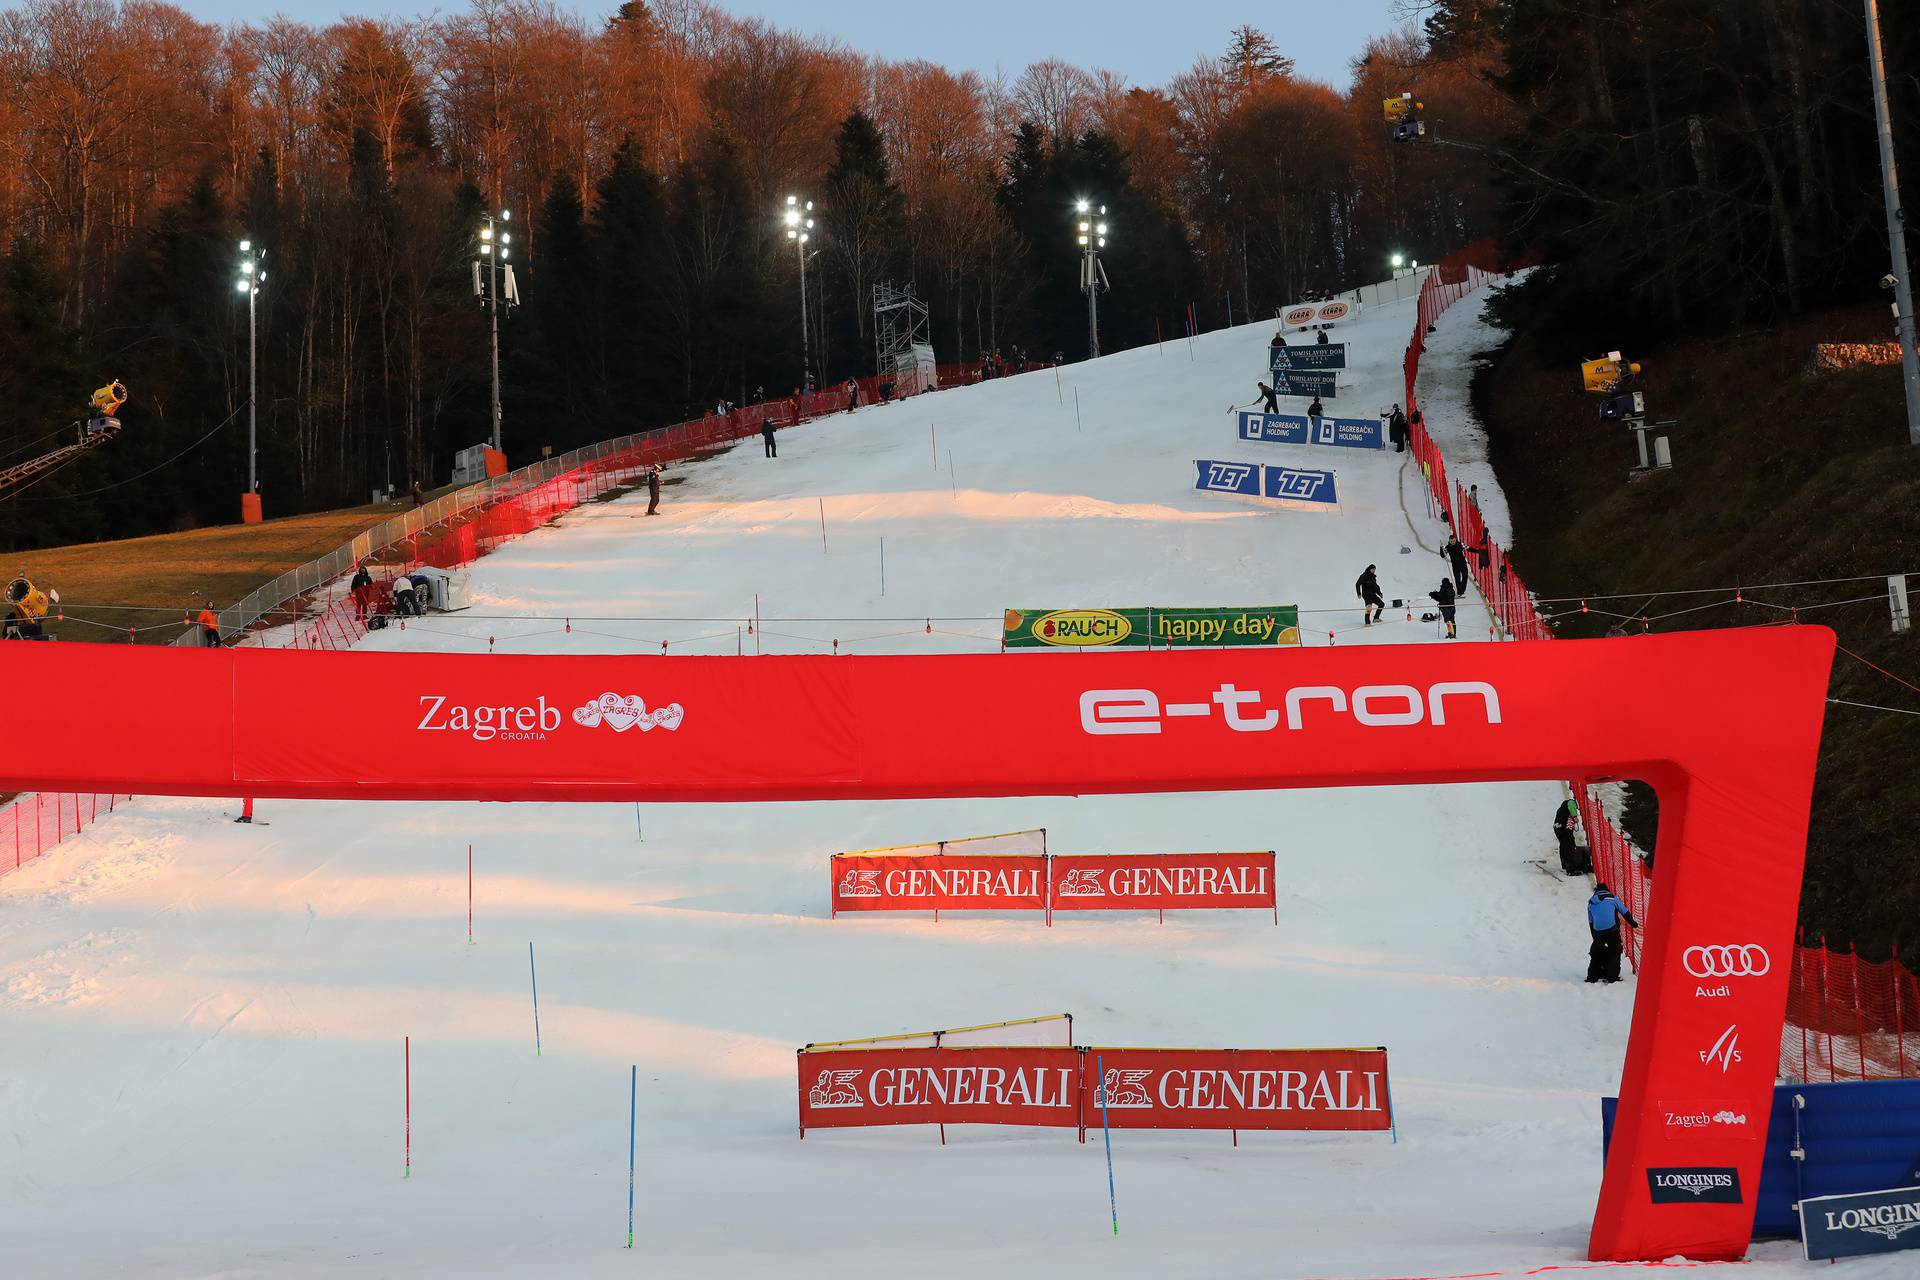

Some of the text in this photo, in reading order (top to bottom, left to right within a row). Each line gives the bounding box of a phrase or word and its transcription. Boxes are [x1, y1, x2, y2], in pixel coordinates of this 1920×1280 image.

[1291, 349, 1328, 357] TOMISLAVOV
[1267, 420, 1300, 430] ZAGREBAČKI
[1338, 425, 1374, 434] ZAGREBAČKI
[1266, 428, 1290, 437] HOLDING
[1338, 433, 1363, 441] HOLDING
[1058, 618, 1119, 637] RAUCH
[1159, 613, 1275, 642] happy day
[603, 705, 639, 717] ZAGREB
[1079, 681, 1502, 735] e-tron
[417, 695, 562, 741] Zagreb
[500, 732, 546, 740] CROATIA
[885, 868, 1042, 897] GENERALI
[1108, 866, 1268, 896] GENERALI
[1695, 985, 1730, 998] Audi
[867, 1066, 1073, 1107] GENERALI
[1157, 1069, 1382, 1111] GENERALI
[1665, 1112, 1711, 1128] Zagreb
[1656, 1174, 1732, 1187] LONGINES
